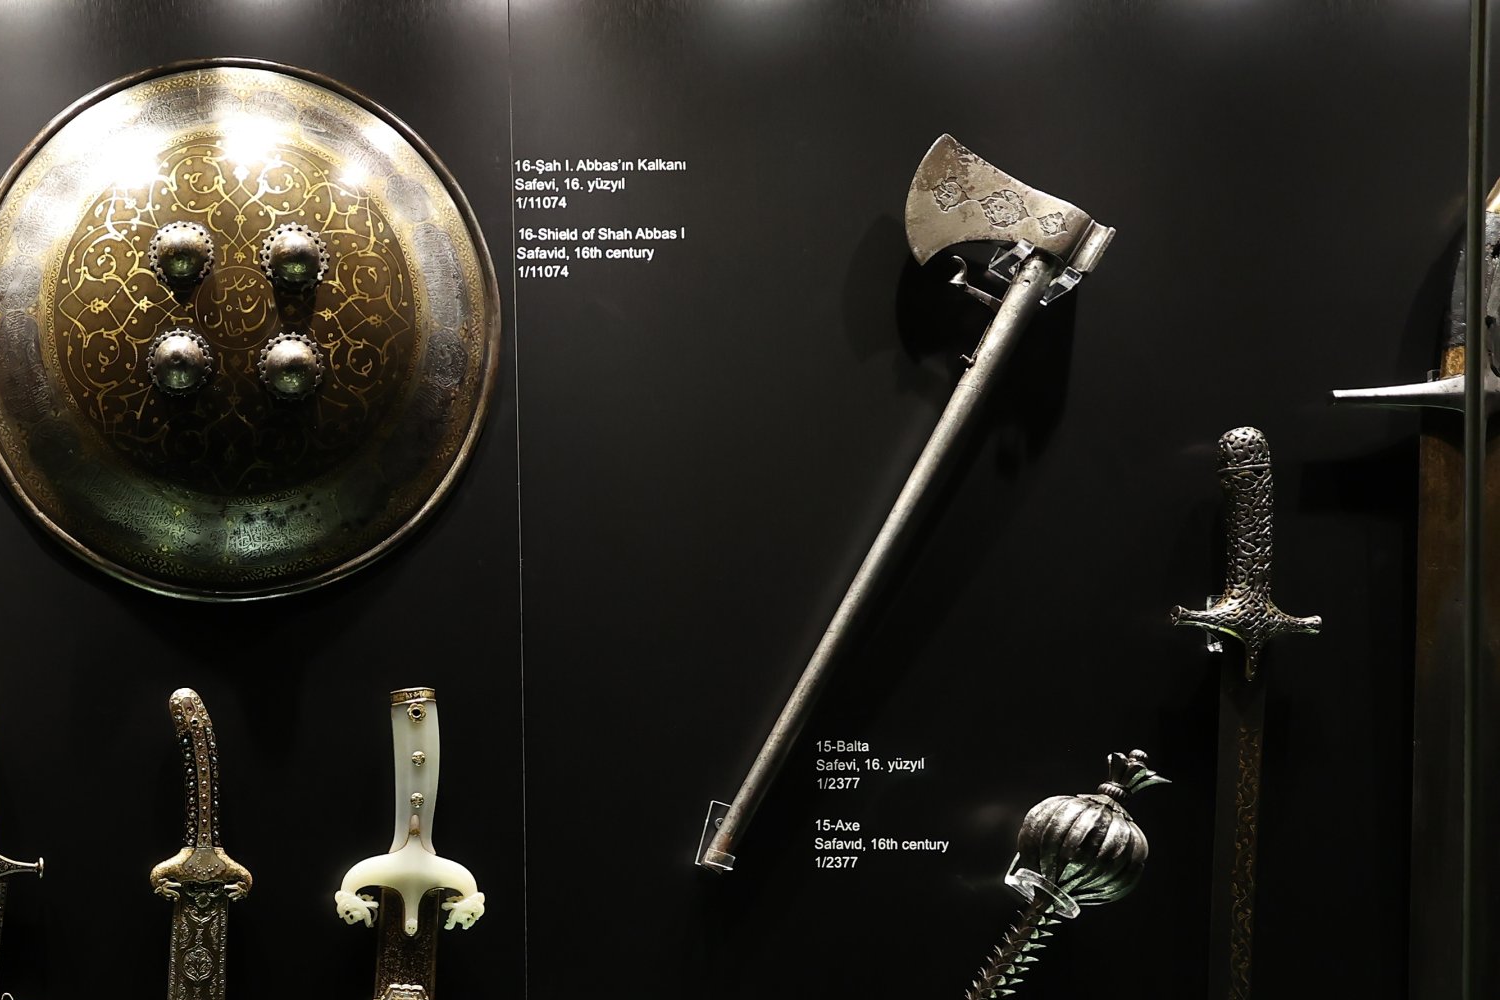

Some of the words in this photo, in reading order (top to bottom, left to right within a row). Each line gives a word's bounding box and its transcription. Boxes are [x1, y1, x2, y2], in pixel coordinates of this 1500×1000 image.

[515, 159, 561, 175] 16-Şah
[515, 178, 559, 192] Safevi,
[564, 177, 584, 190] 16.
[515, 196, 567, 209] 1/11074
[518, 227, 578, 241] 16-Shield
[581, 227, 596, 240] of
[598, 227, 633, 240] Shah
[635, 227, 677, 240] Abbas
[516, 246, 570, 261] Safavid,
[574, 246, 602, 259] 16th
[605, 247, 655, 261] century
[518, 265, 569, 278] 1/11074
[816, 740, 870, 752] 15-Balta
[816, 758, 860, 772] Safevi,
[865, 758, 884, 770] 16.
[817, 777, 860, 790] 1/2377
[815, 819, 860, 832] 15-Axe
[871, 838, 898, 850] 16th
[901, 838, 949, 853] century
[815, 856, 858, 869] 1/2377
